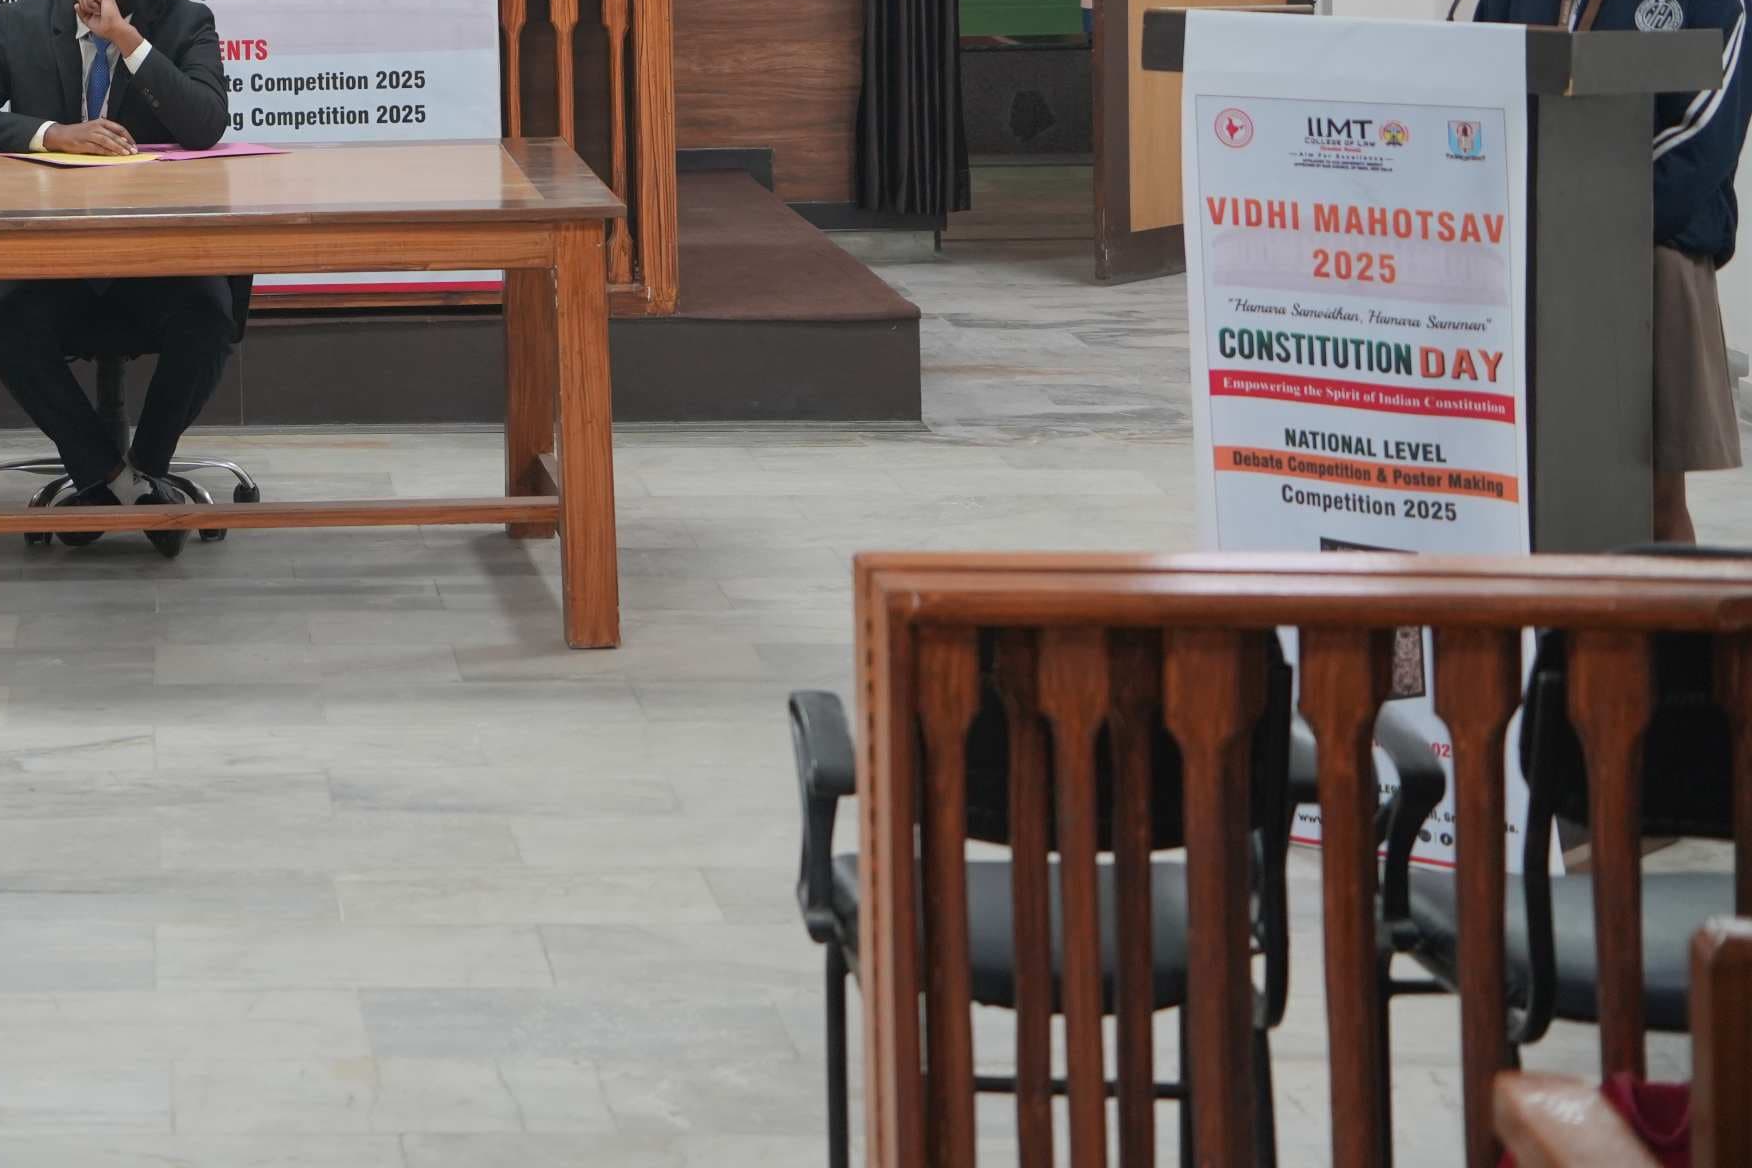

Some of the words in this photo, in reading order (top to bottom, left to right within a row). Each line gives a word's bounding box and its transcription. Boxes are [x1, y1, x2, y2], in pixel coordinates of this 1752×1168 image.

[250, 71, 369, 95] Competition
[375, 70, 426, 91] 2025
[251, 107, 369, 130] Competition
[376, 104, 426, 124] 2025
[1308, 117, 1373, 139] IIMT
[1206, 196, 1299, 231] VIDHI
[1313, 203, 1504, 244] MAHOTSAV
[1313, 248, 1396, 284] 2025
[1368, 309, 1421, 329] Hamara
[1218, 327, 1412, 376] CONSTITUTION
[1419, 346, 1503, 382] DAY
[1223, 377, 1301, 397] Empowering
[1304, 384, 1324, 397] the
[1326, 385, 1361, 403] Spirit
[1363, 390, 1376, 403] of
[1379, 391, 1420, 408] Indian
[1424, 395, 1506, 415] Constitution
[1284, 428, 1377, 458] NATIONAL
[1384, 440, 1447, 464] LEVEL
[1232, 450, 1283, 470] Debate
[1287, 454, 1371, 483] Competition
[1376, 467, 1388, 483] &
[1393, 469, 1443, 488] Poster
[1448, 475, 1504, 498] Making
[1281, 483, 1396, 517] Competition
[1403, 499, 1458, 522] 2025
